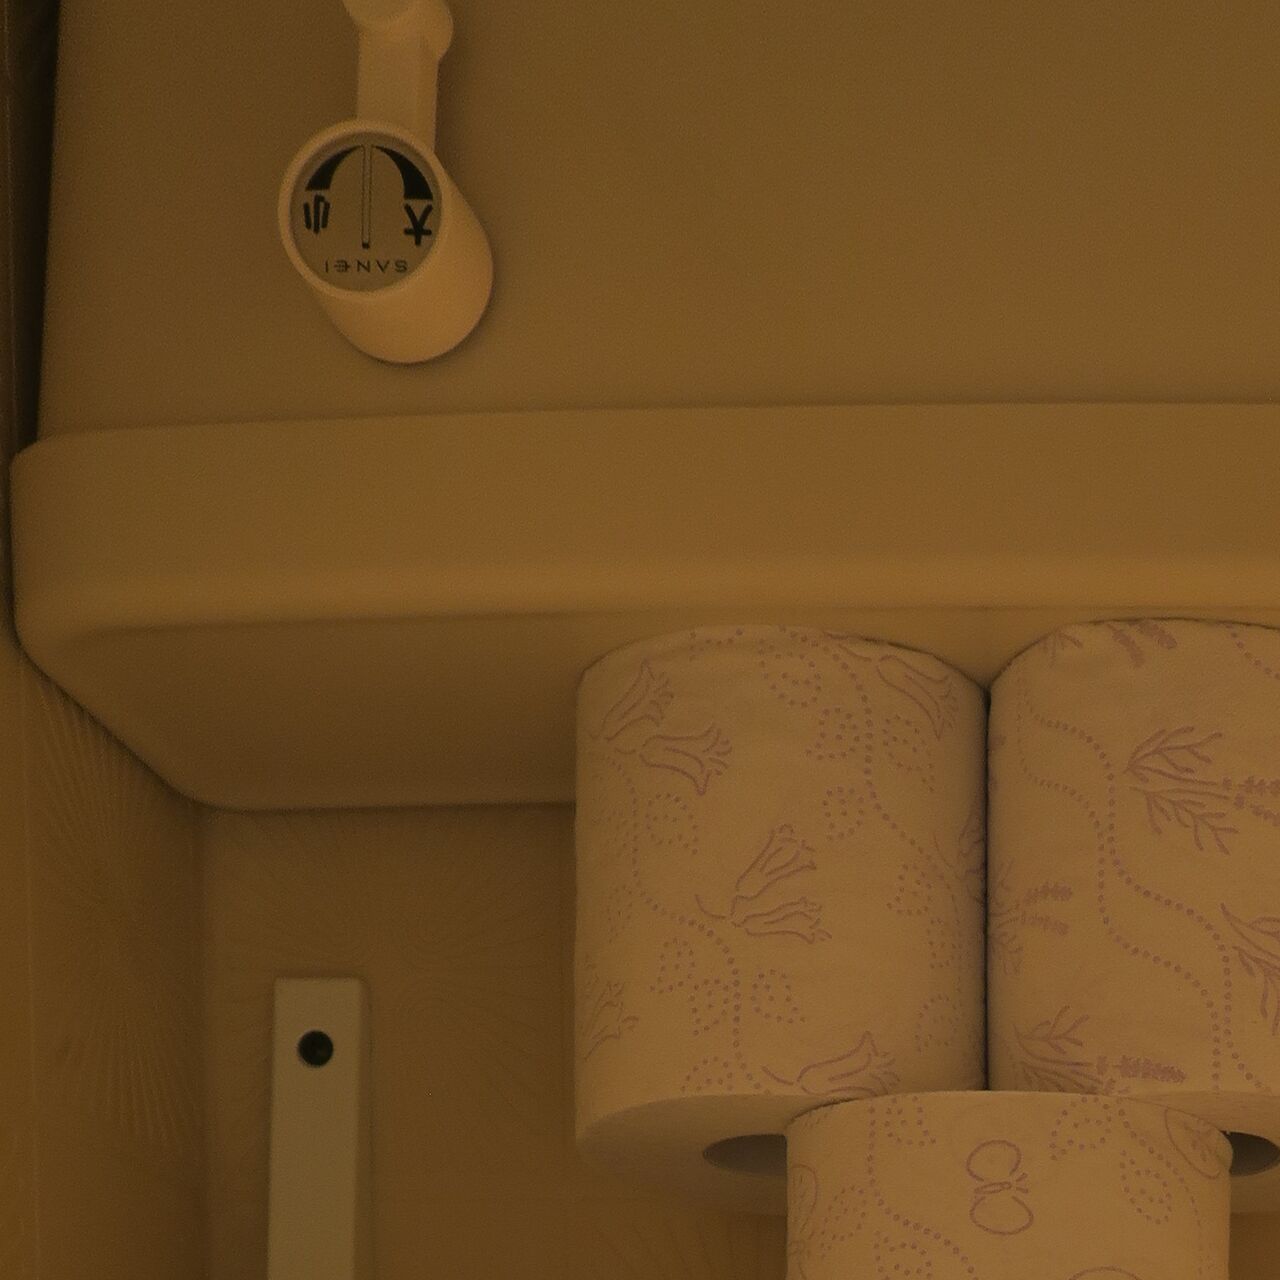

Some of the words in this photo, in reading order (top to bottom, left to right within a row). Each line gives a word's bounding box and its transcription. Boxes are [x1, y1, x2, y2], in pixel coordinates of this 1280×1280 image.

[303, 194, 330, 235] 小
[404, 204, 433, 247] 大
[325, 259, 408, 274] SANEI
